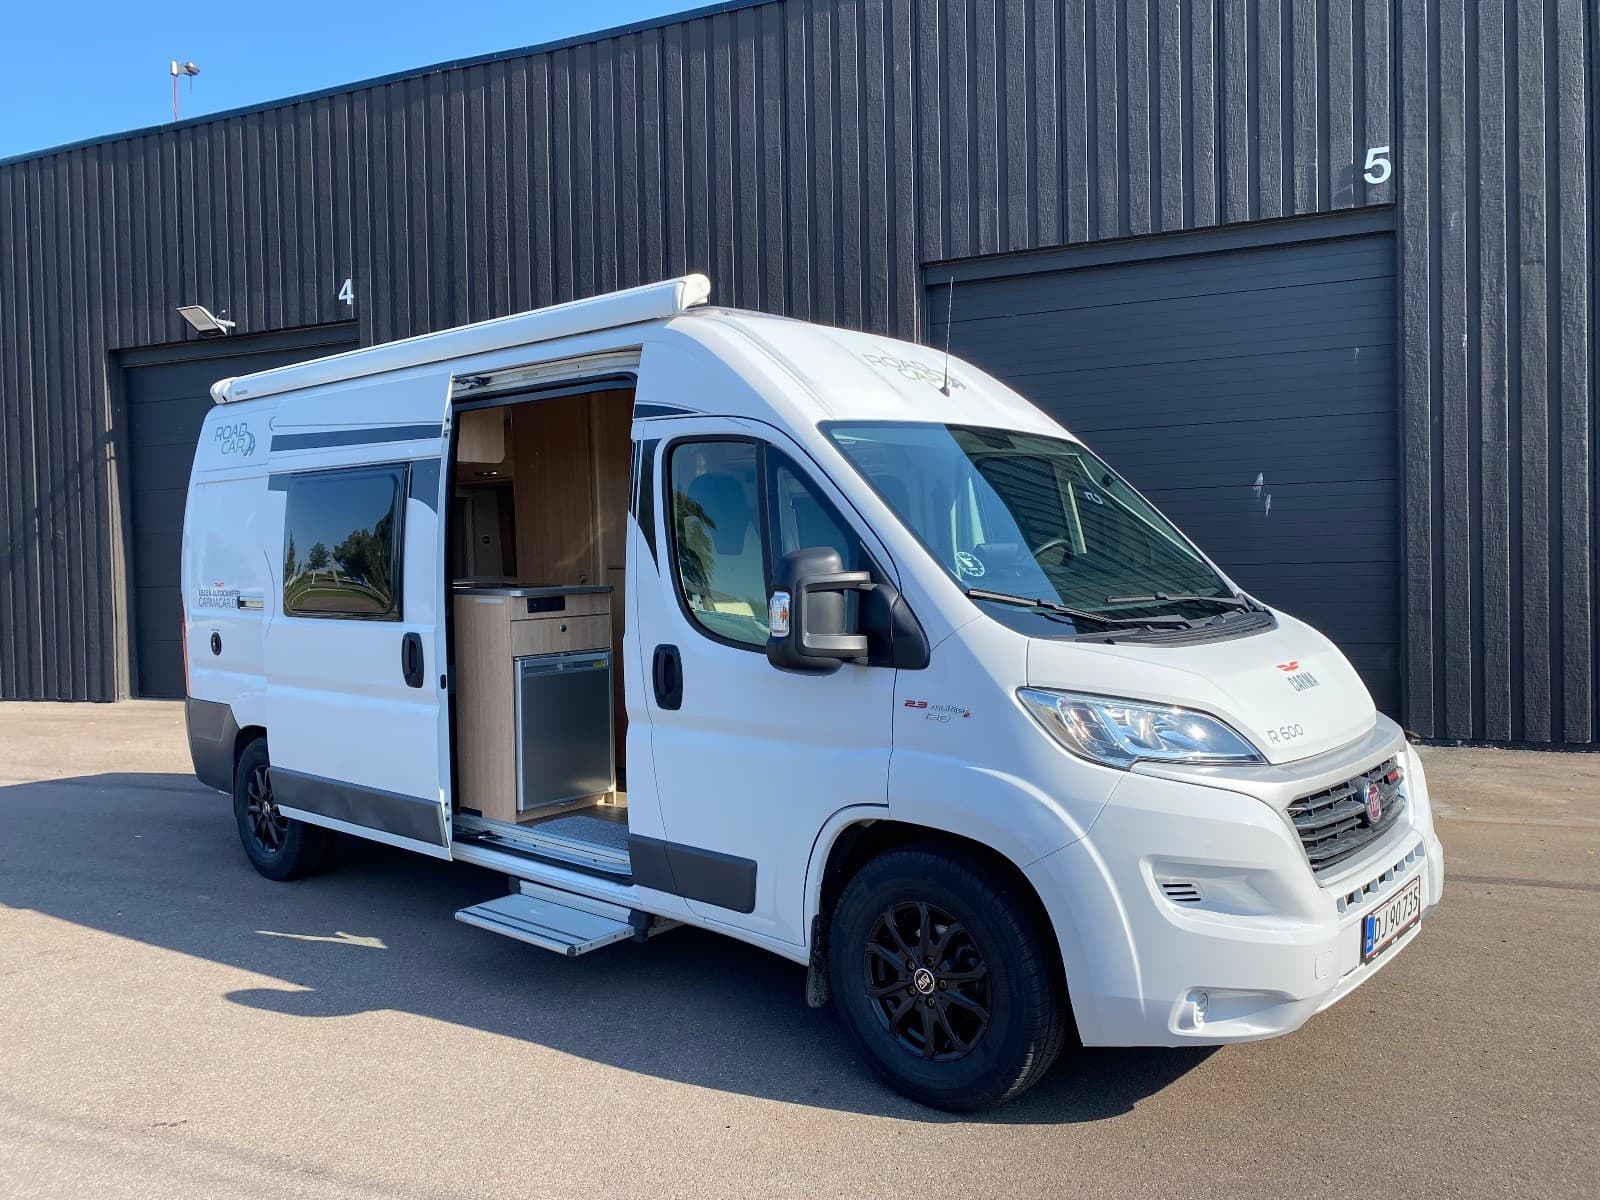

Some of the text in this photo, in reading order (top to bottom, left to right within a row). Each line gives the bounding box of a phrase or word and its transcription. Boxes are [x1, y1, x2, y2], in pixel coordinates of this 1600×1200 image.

[1363, 145, 1392, 185] 5
[338, 278, 354, 305] 4
[862, 352, 931, 374] ROAD
[214, 422, 248, 441] ROAD
[221, 437, 247, 455] CAR
[1267, 723, 1304, 744] R 600
[1374, 886, 1418, 943] DJ 90 735
